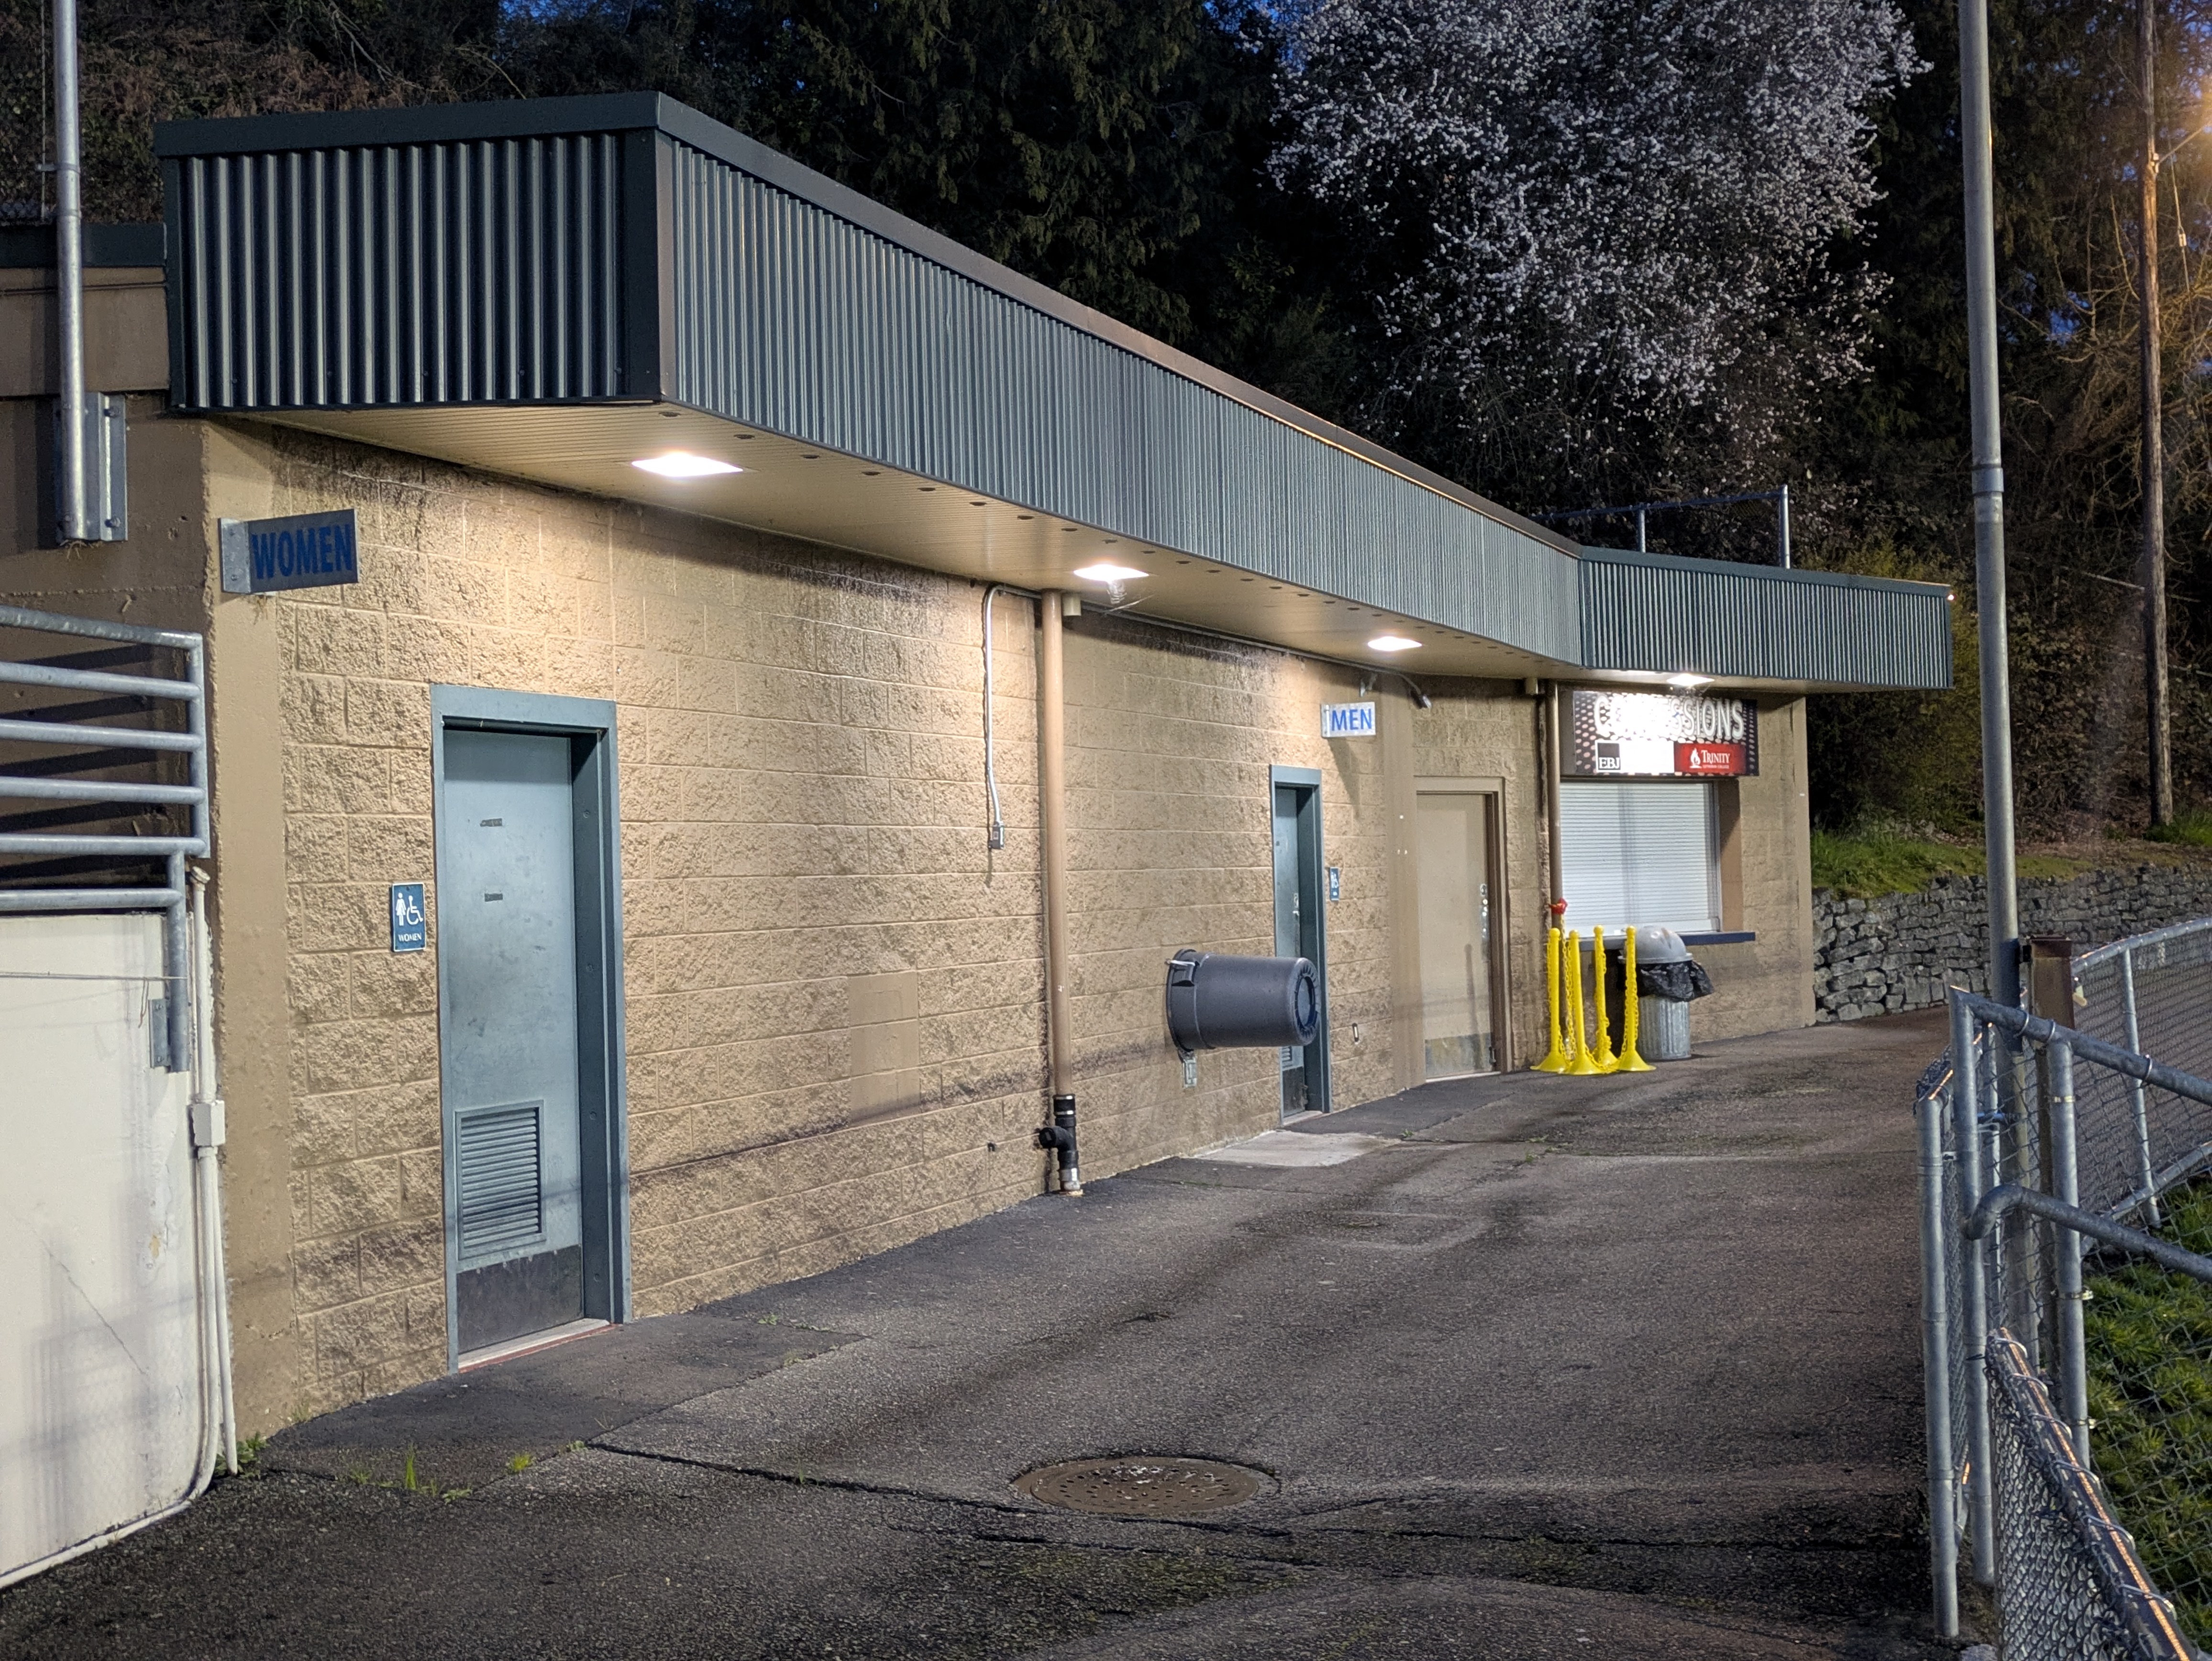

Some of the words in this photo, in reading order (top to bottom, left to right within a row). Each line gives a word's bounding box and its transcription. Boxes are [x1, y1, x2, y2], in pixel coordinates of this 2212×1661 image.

[251, 524, 353, 580] WOMEN
[1331, 709, 1372, 731] MEN
[1599, 757, 1620, 769] EBJ
[1701, 750, 1730, 764] TRINITY
[398, 933, 422, 942] WOMEN
